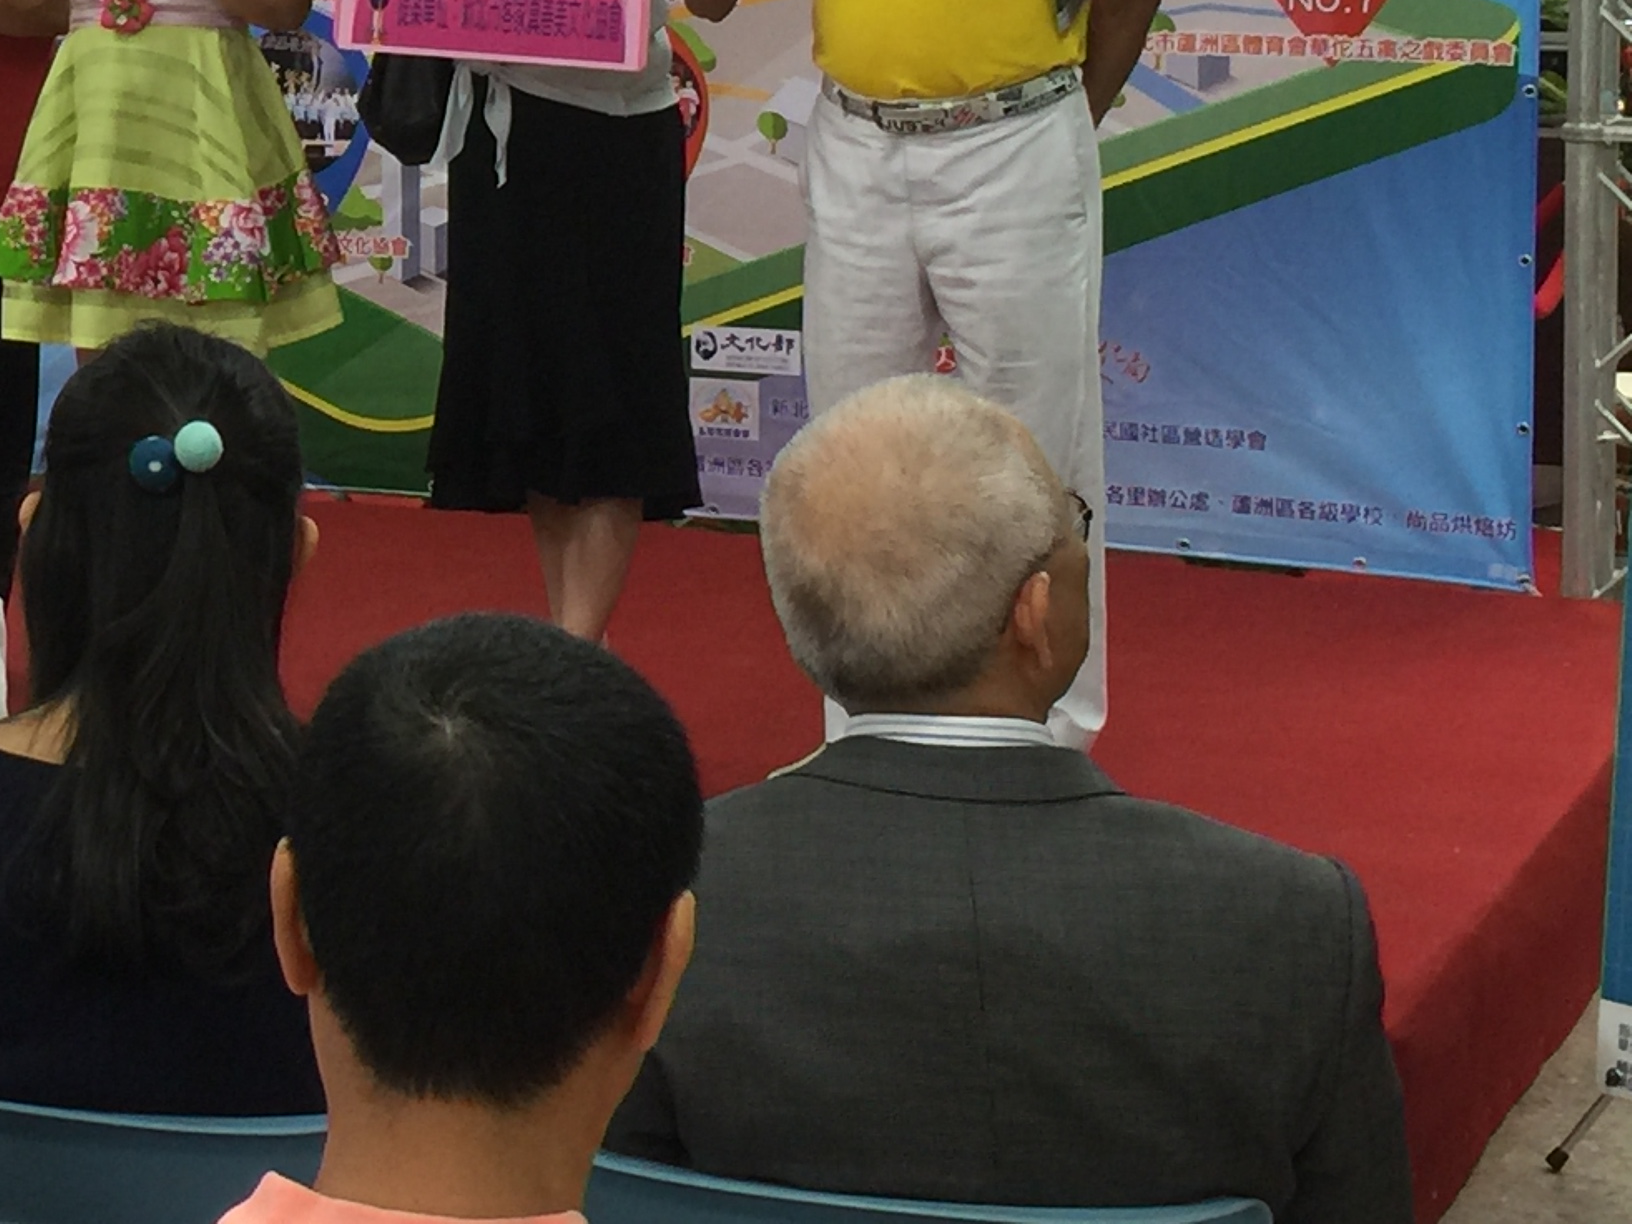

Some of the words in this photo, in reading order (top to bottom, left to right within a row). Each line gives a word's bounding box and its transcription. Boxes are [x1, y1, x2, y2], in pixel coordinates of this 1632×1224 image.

[720, 333, 796, 355] 文化部
[697, 454, 772, 477] 洲區各
